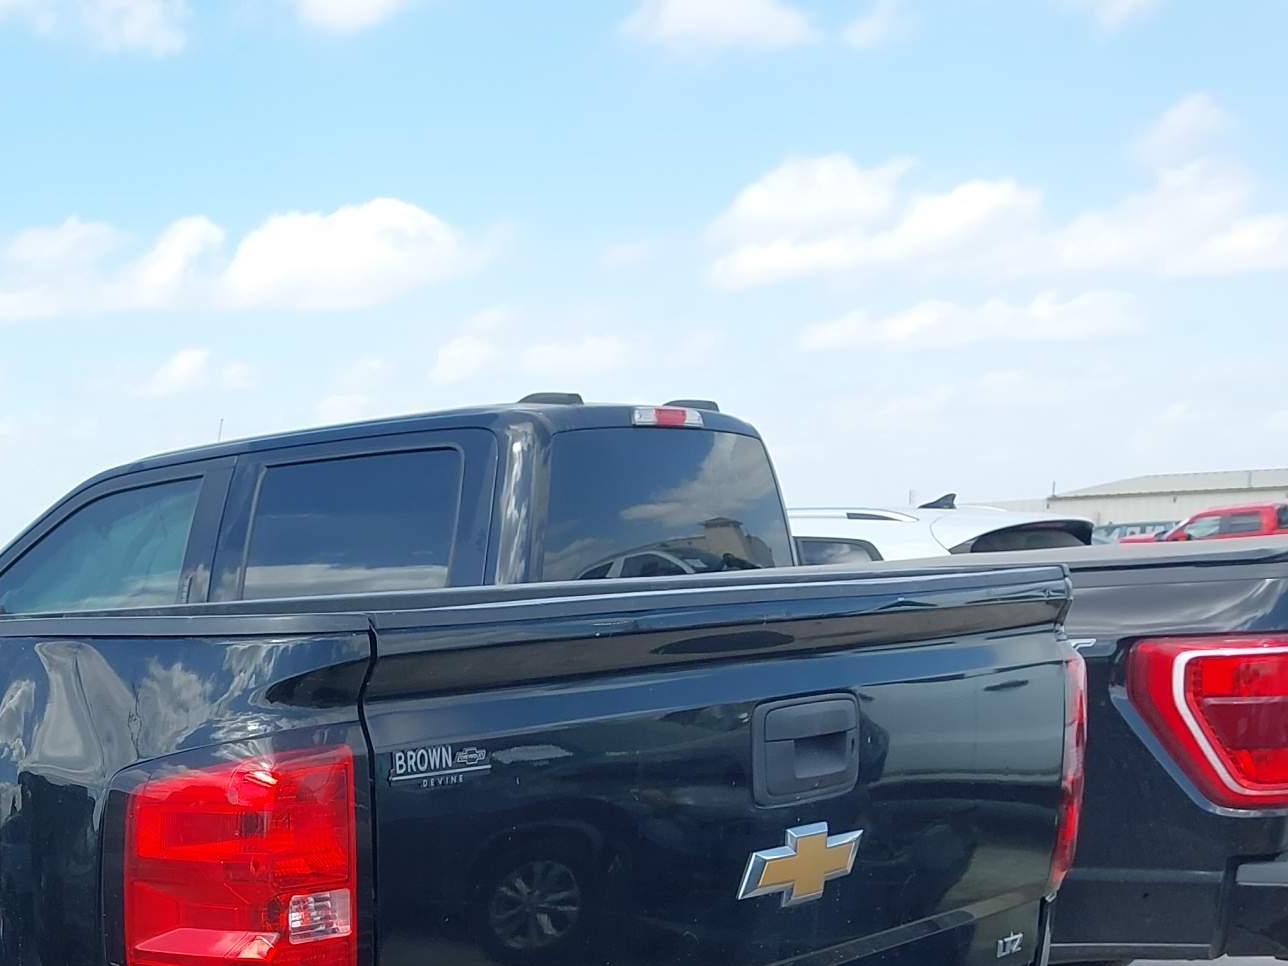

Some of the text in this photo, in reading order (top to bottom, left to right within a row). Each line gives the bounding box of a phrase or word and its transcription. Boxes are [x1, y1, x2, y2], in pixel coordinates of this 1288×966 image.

[394, 745, 453, 775] BROWN
[422, 774, 464, 788] DEVINE
[996, 930, 1023, 958] LTZ
